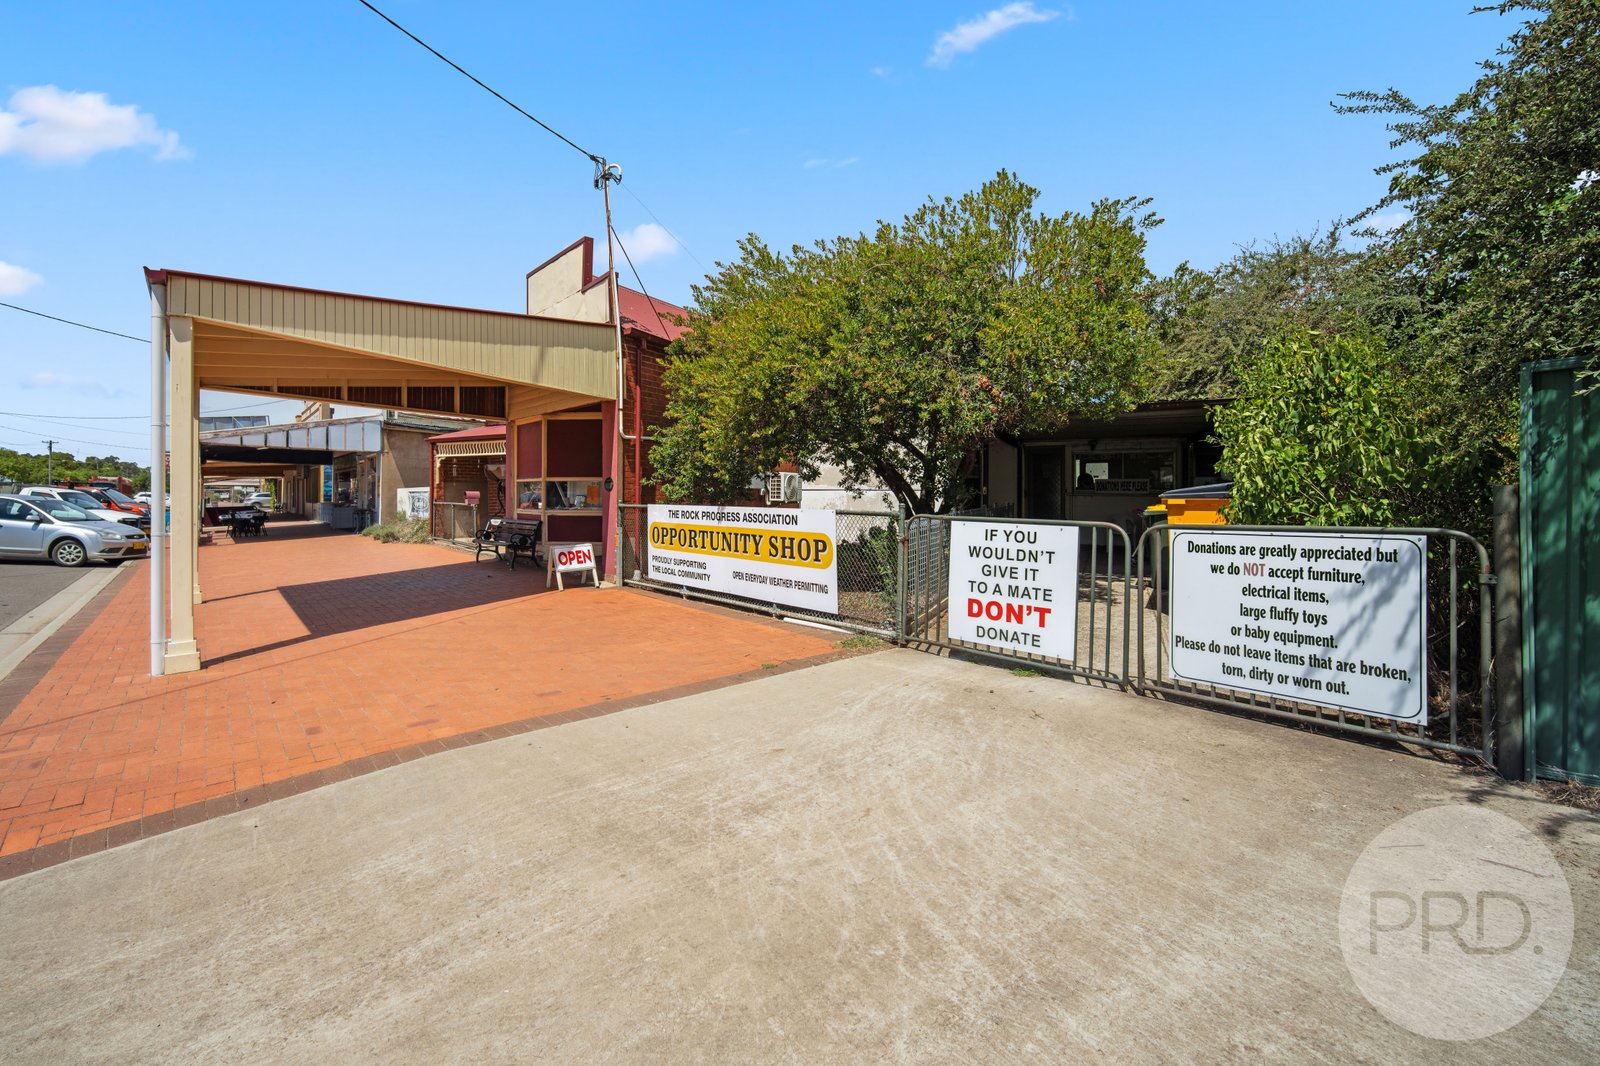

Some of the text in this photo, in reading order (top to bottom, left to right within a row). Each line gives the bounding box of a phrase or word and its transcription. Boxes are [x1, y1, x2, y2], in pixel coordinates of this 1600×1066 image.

[668, 510, 798, 525] THE ROCK PROGRESS ASSOCIATION
[652, 526, 828, 563] OPPORTUNITY SHOP
[985, 529, 1037, 543] IF YOU
[558, 550, 592, 566] OPEN
[652, 555, 707, 569] PROUDLY SUPPORTING
[1188, 541, 1398, 564] Donations are greatly appreciated but
[661, 567, 676, 576] LOCAL
[677, 569, 710, 581] COMMUNITY
[732, 571, 828, 594] OPEN EVERYDAY WEATHER PERMITTING
[982, 565, 1039, 581] GIVE IT
[1210, 563, 1365, 585] we do NOT accept furniture,
[968, 580, 1052, 602] TO A MATE
[1242, 584, 1329, 604] electrical items,
[1240, 604, 1328, 627] large fluffy toys
[976, 626, 1040, 647] DONATE
[1231, 625, 1338, 649] or baby equipment.
[1175, 636, 1412, 683] Please do not leave items that are broken,
[1222, 663, 1349, 695] torn, dirty or worn out.
